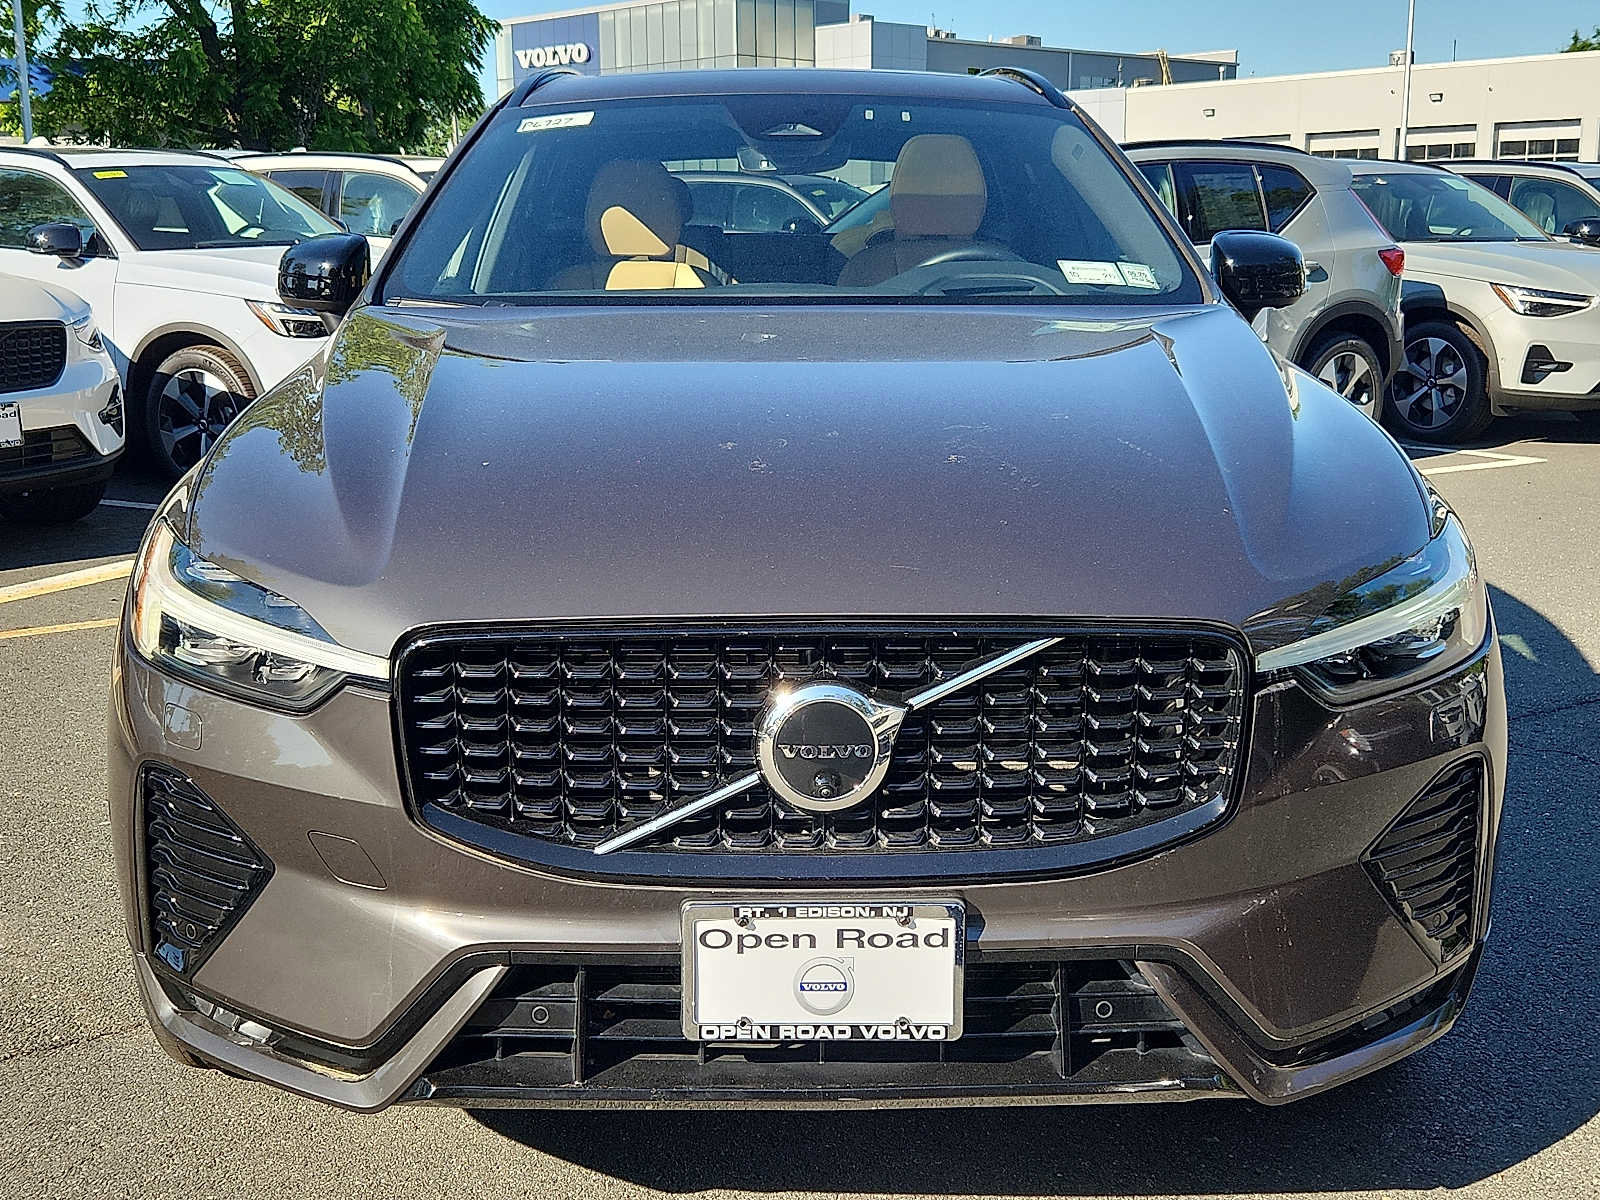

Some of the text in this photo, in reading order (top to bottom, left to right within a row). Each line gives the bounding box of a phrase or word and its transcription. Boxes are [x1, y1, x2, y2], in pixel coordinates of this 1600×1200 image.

[515, 43, 590, 69] VOLVO
[0, 410, 16, 418] ad
[778, 744, 873, 759] VOLVO
[739, 907, 769, 918] RT.
[778, 907, 788, 918] 1
[882, 907, 909, 918] NJ
[699, 928, 949, 954] Open Road
[802, 982, 846, 991] VOLVO
[701, 1025, 949, 1039] OPEN ROAD VOLVO
